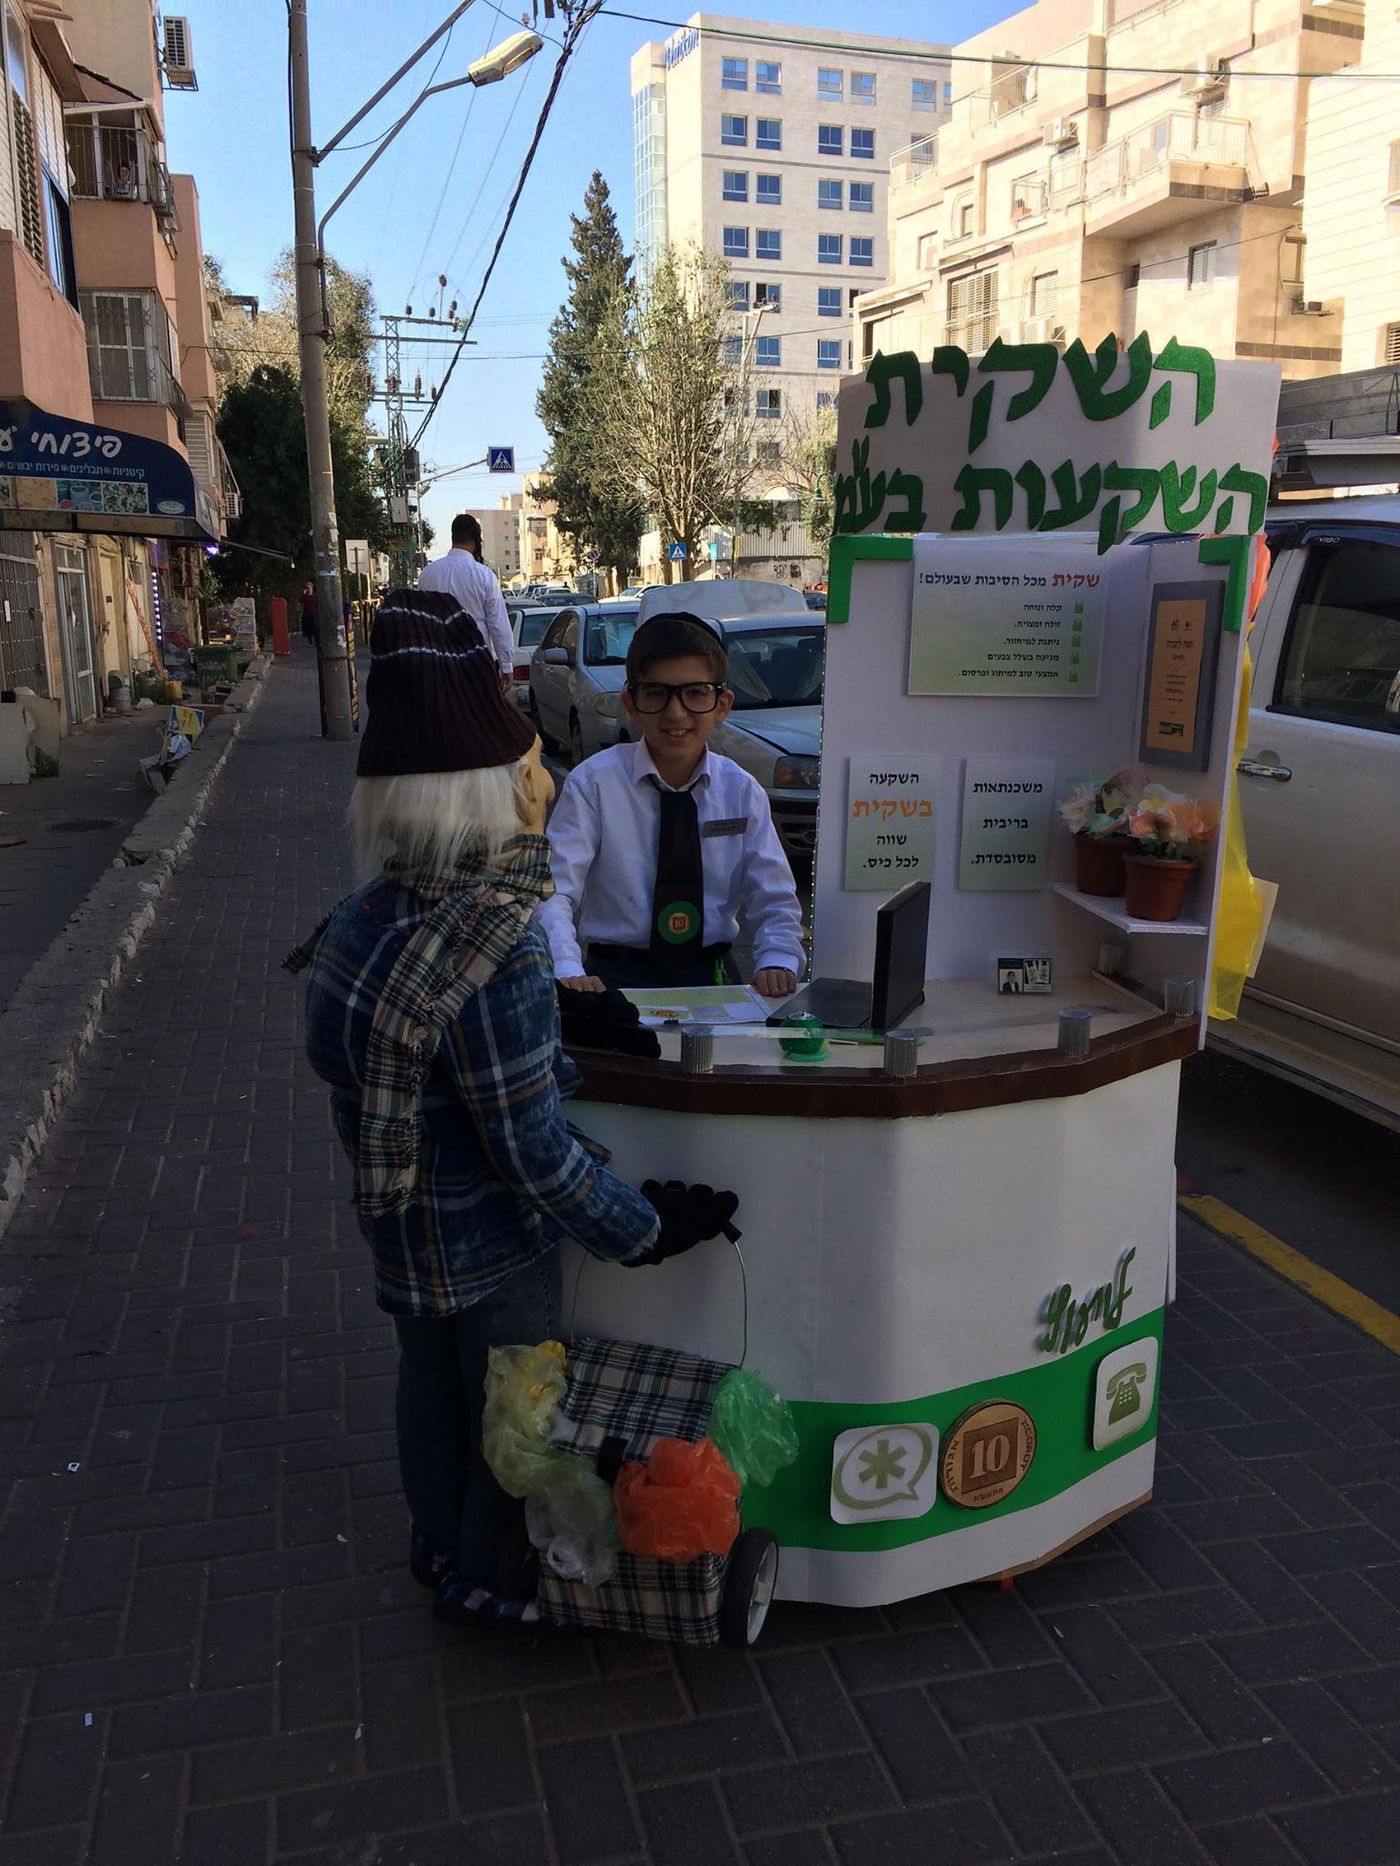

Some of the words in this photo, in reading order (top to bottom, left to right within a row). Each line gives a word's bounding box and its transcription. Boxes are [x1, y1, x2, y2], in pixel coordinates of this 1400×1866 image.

[864, 330, 1217, 455] השקית
[31, 431, 122, 458] פיצוחי
[35, 462, 60, 472] פירות
[69, 462, 103, 475] תבלינים
[112, 467, 145, 479] קיטניות
[831, 434, 927, 537] בע"מ
[950, 458, 1268, 556] השקעות
[919, 572, 972, 586] שבעולם!
[975, 573, 1020, 587] הסיבות
[1023, 574, 1047, 587] מכל
[1052, 572, 1100, 588] שקית
[1024, 604, 1044, 612] ונוחה
[1046, 603, 1062, 612] קלה
[1044, 620, 1061, 628] זולה
[1038, 638, 1060, 646] ניתנת
[987, 653, 1011, 661] צבעים
[1013, 652, 1034, 661] בשלל
[1036, 653, 1059, 661] מגיעה
[869, 772, 919, 787] השקעה
[973, 782, 1043, 793] משכנתאות
[852, 799, 933, 822] בשקית
[982, 817, 1029, 829] בריבית
[876, 834, 907, 846] שווה
[863, 856, 892, 869] כיס.
[896, 854, 919, 868] לכל
[971, 852, 1037, 865] מסובסדת.
[969, 1434, 1010, 1479] 10
